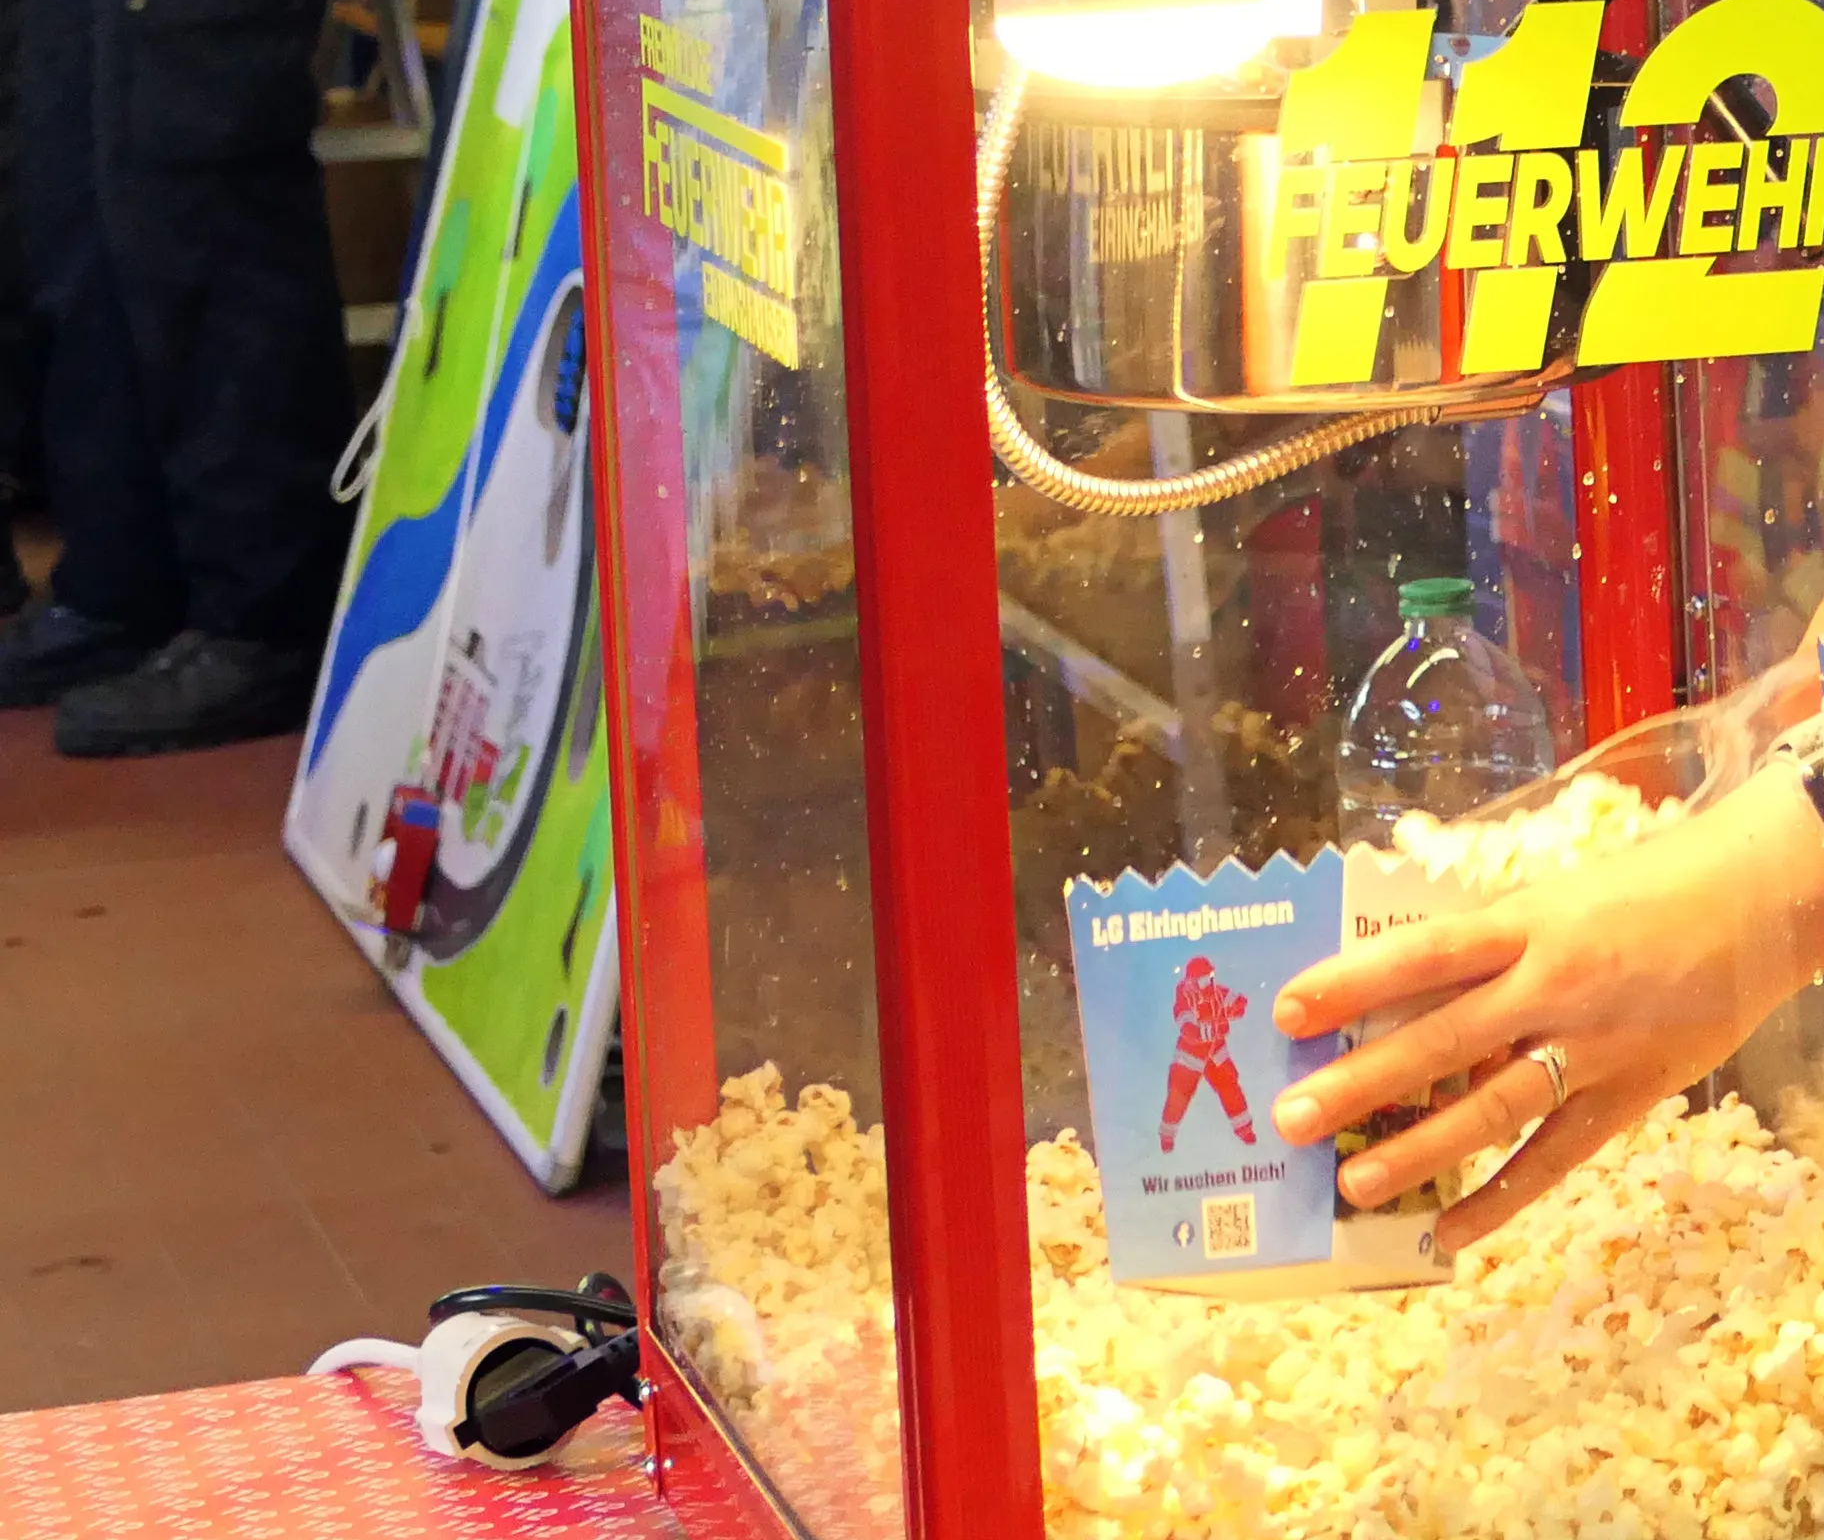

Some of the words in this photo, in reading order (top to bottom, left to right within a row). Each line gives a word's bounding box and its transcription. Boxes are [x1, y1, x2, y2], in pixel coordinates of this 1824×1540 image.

[641, 77, 797, 300] FEUERWEHR
[1092, 915, 1126, 948] LG
[1128, 900, 1296, 942] Eiringhausen
[1141, 1176, 1169, 1196] Wir
[1174, 1170, 1237, 1192] suchen
[1241, 1161, 1286, 1184] Dich!
